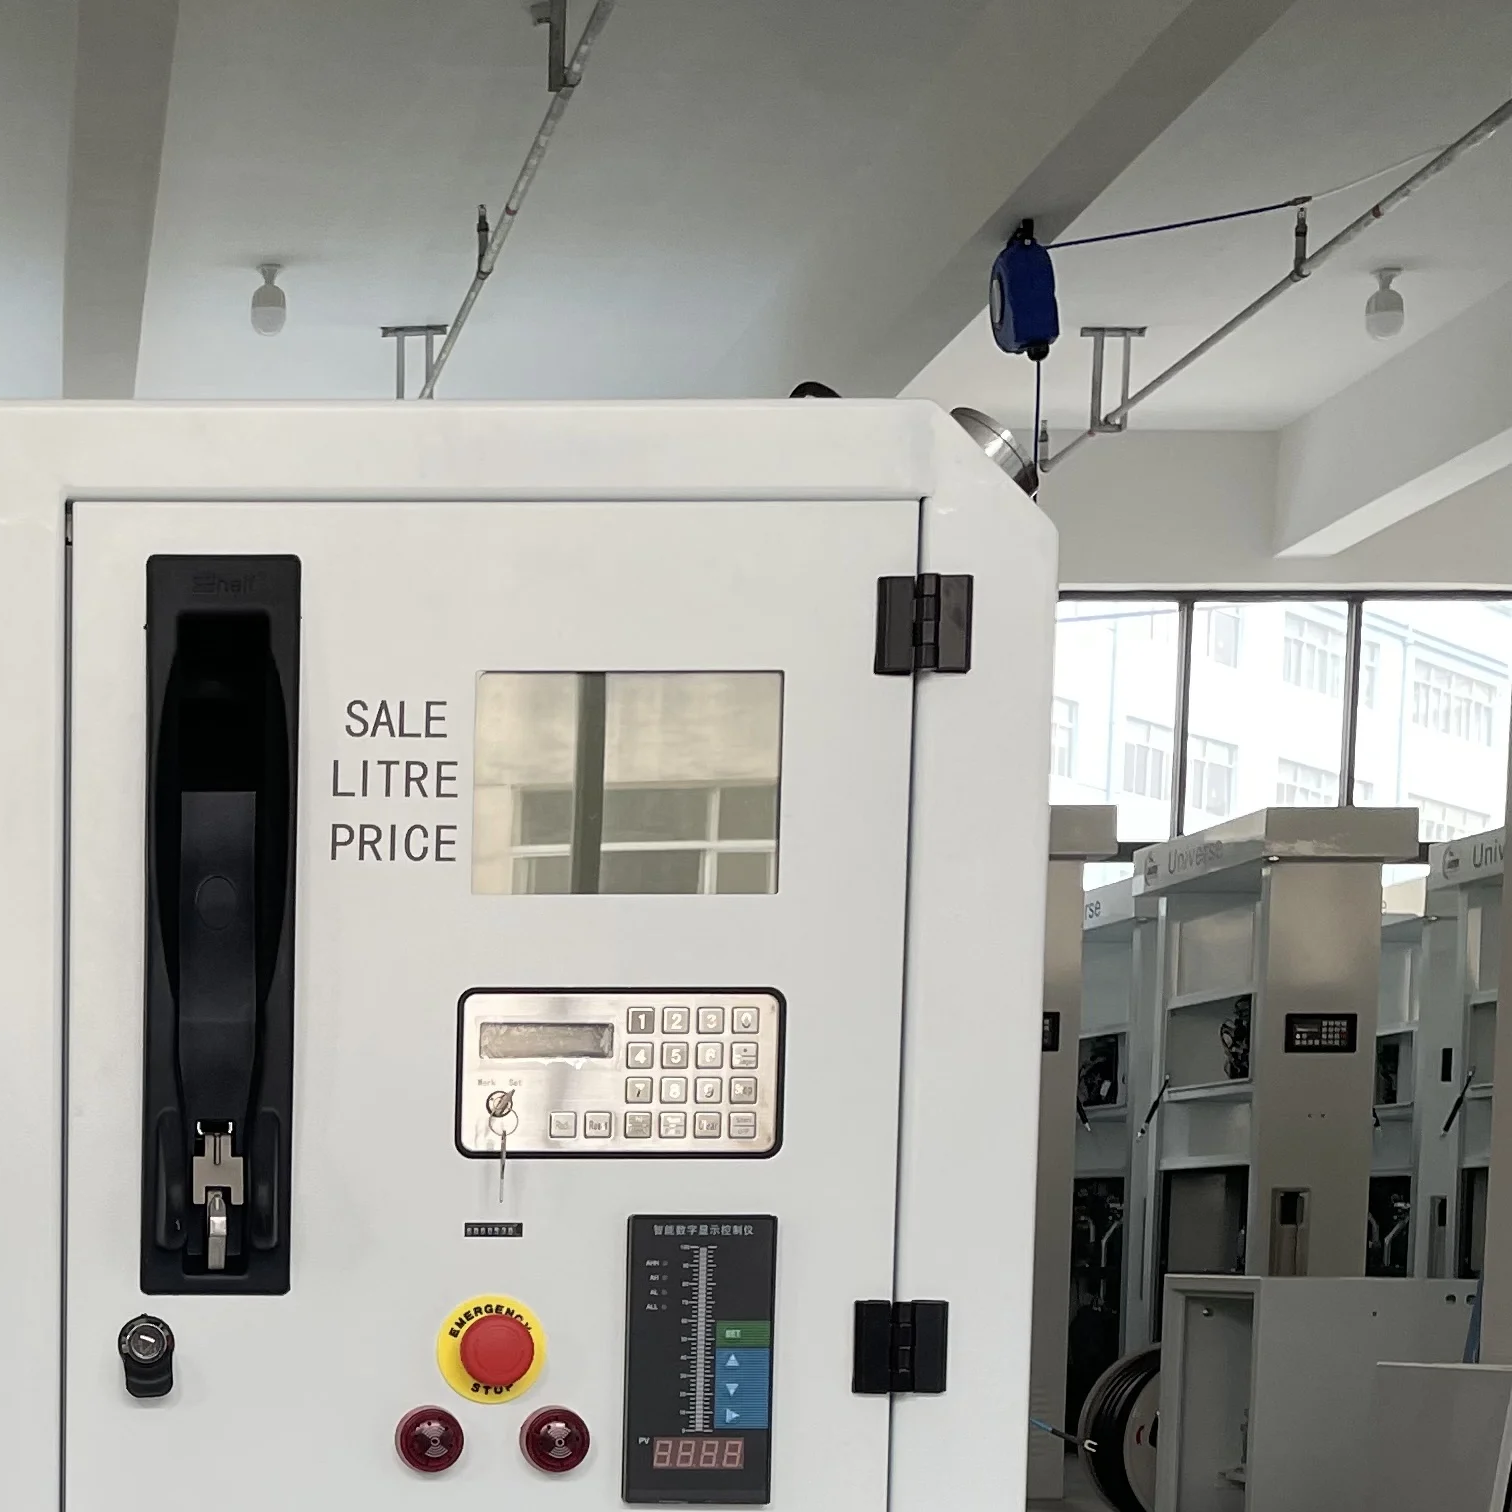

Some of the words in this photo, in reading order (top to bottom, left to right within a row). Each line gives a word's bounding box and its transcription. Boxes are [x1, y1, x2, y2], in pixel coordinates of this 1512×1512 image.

[345, 699, 448, 738] SALE
[332, 759, 458, 798] LITRE
[330, 823, 457, 862] PRICE
[1167, 839, 1224, 875] Universe
[638, 1013, 646, 1030] 1
[670, 1013, 683, 1030] 2
[706, 1014, 717, 1029] 3
[634, 1048, 647, 1064] 4
[670, 1048, 682, 1064] 5
[634, 1083, 646, 1098] 7
[669, 1083, 681, 1099] 8
[703, 1083, 715, 1099] 9
